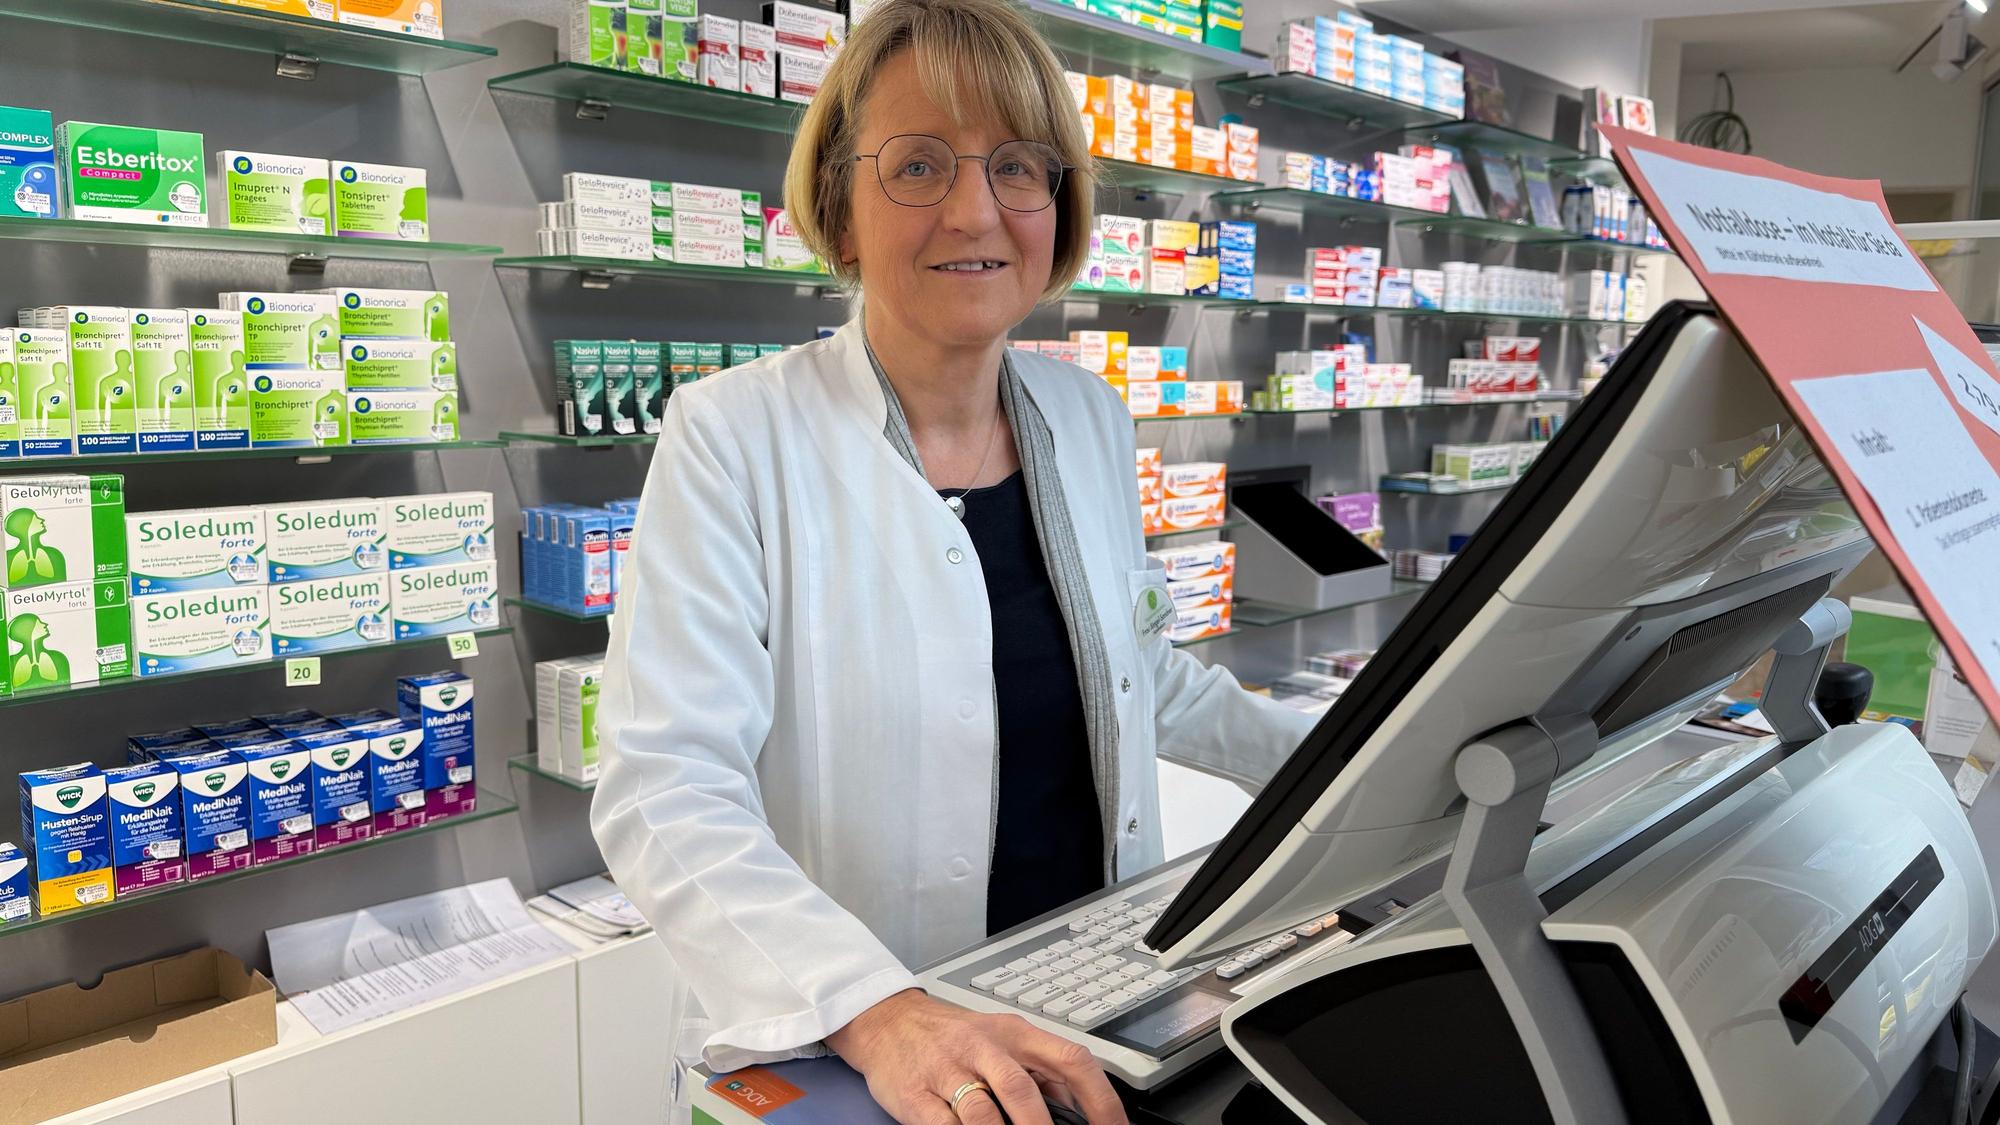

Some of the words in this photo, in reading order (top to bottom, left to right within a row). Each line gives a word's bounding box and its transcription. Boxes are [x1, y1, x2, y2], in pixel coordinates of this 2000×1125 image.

[77, 146, 195, 173] Esberitox
[86, 169, 137, 180] Compact
[257, 163, 304, 176] Bionorica
[362, 173, 404, 184] Bionorica
[234, 182, 275, 195] Imupret
[282, 186, 290, 194] N
[234, 194, 267, 203] Dragees
[341, 191, 386, 203] Tonsipret
[341, 201, 375, 211] Tabletten
[236, 215, 246, 223] 50
[1686, 202, 1787, 241] Notfalldose
[1787, 217, 1814, 245] im
[1809, 222, 1852, 251] Notfall
[1847, 229, 1870, 253] für
[1868, 232, 1890, 256] Sie
[269, 302, 314, 312] Bionorica
[365, 298, 407, 307] Bionorica
[92, 315, 125, 323] Bionorica
[152, 316, 185, 324] Bionorica
[344, 312, 389, 321] Bronchipret
[248, 322, 302, 334] Bronchipret
[75, 332, 121, 341] Bronchipret
[136, 333, 180, 341] Bronchipret
[195, 333, 236, 342] Bronchipret
[249, 333, 259, 341] TP
[76, 341, 92, 349] Saft
[93, 341, 103, 349] TE
[136, 341, 152, 349] Saft
[153, 341, 162, 349] TE
[196, 342, 211, 350] Saft
[372, 350, 415, 359] Bionorica
[351, 365, 397, 373] Bronchipret
[277, 380, 321, 389] Bionorica
[255, 400, 310, 411] Bronchipret
[375, 401, 417, 410] Bionorica
[355, 416, 399, 425] Bronchipret
[82, 437, 99, 446] 100
[142, 435, 158, 444] 100
[200, 433, 216, 441] 100
[25, 442, 34, 450] 50
[10, 483, 83, 499] GeloMyrtol
[64, 496, 83, 505] forte
[396, 502, 485, 523] Soledum
[277, 510, 377, 533] Soledum
[458, 519, 485, 529] forte
[139, 518, 254, 543] Soledum
[347, 528, 377, 538] forte
[220, 538, 255, 549] forte
[401, 570, 488, 592] Soledum
[279, 581, 379, 605] Soledum
[462, 586, 488, 596] forte
[13, 588, 86, 605] GeloMyrtol
[68, 600, 87, 608] forte
[350, 599, 380, 609] forte
[146, 596, 258, 623] Soledum
[225, 613, 259, 625] forte
[455, 640, 471, 651] 50
[294, 667, 311, 680] 20
[271, 765, 289, 773] WICK
[207, 776, 225, 786] WICK
[321, 770, 365, 787] MediNait
[58, 791, 82, 801] WICK
[134, 786, 154, 796] WICK
[259, 783, 306, 800] MediNait
[193, 795, 242, 814] MediNait
[121, 806, 173, 825] MediNait
[41, 814, 103, 830] Husten-Sirup
[50, 828, 67, 837] gegen
[1859, 916, 1879, 952] ADG
[737, 1087, 774, 1107] ADG
